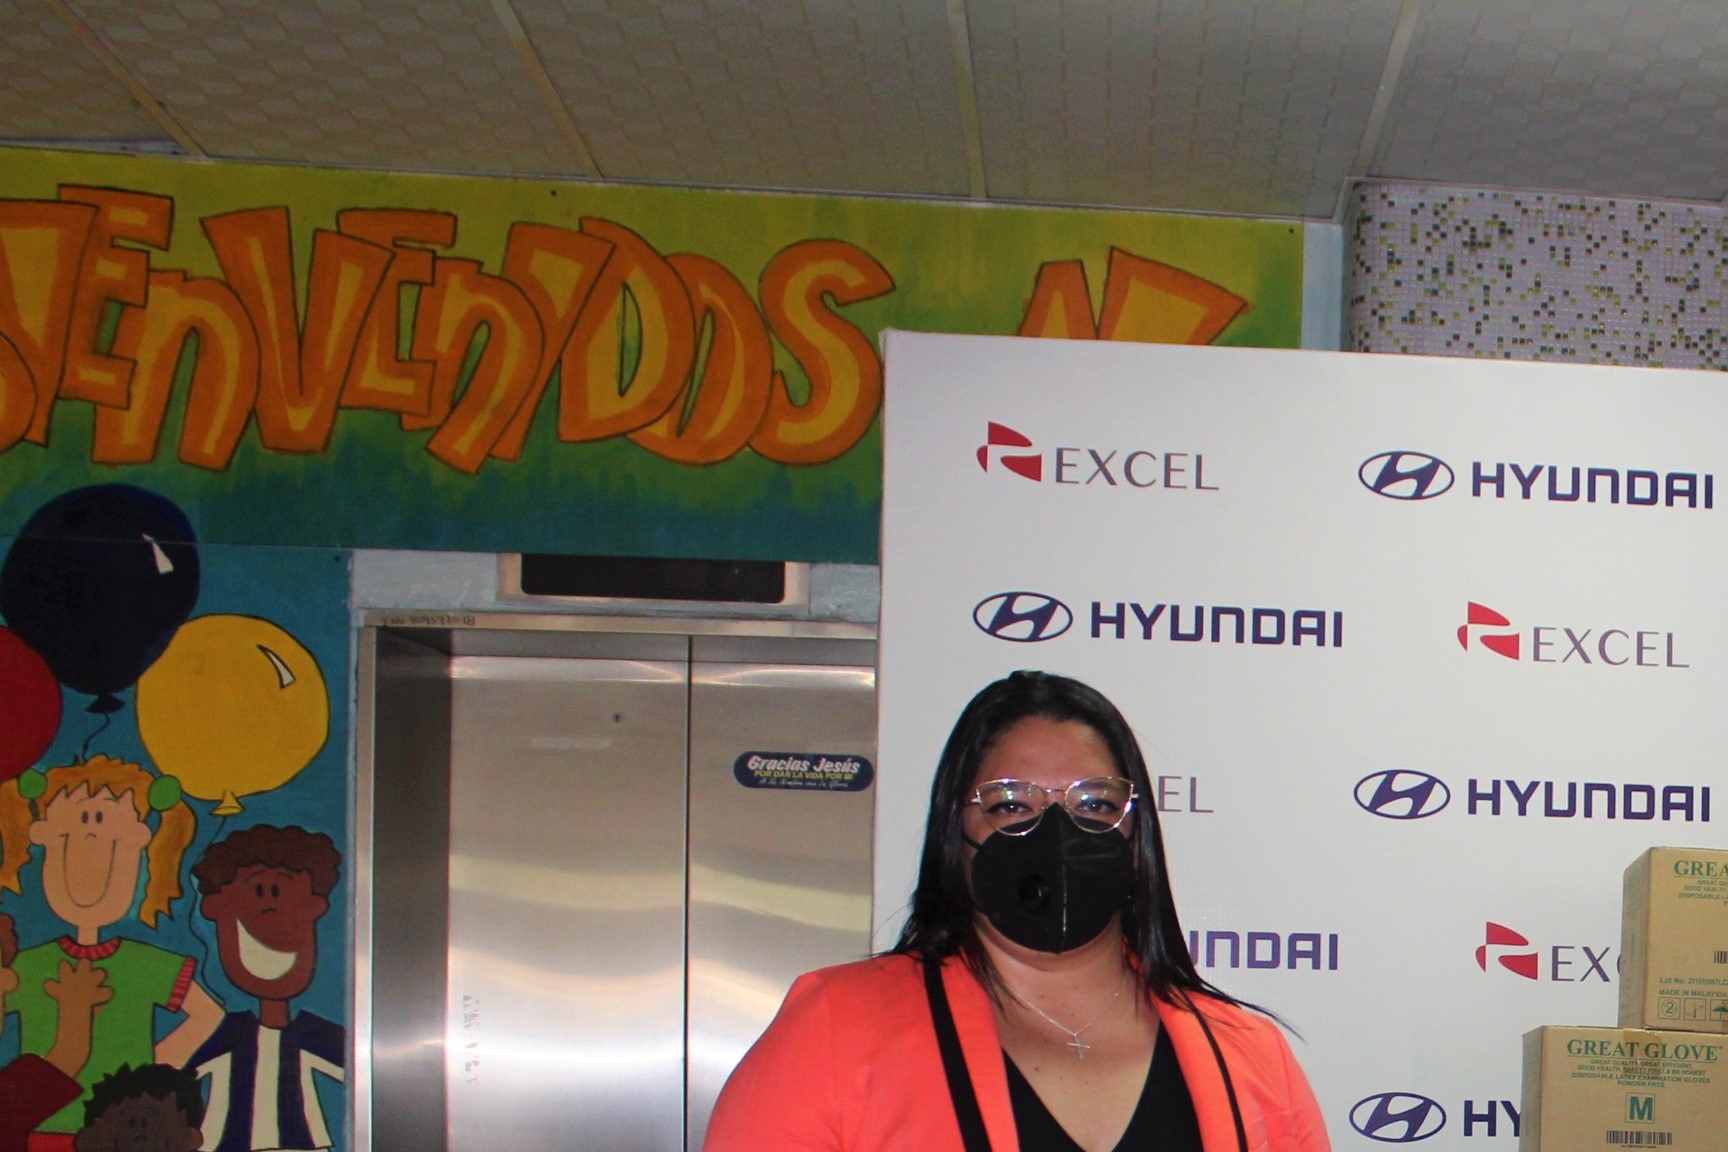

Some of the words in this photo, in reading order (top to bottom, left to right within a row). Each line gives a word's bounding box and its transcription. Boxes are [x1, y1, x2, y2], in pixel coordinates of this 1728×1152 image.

[0, 183, 894, 474] IENVENIDOS
[1055, 447, 1220, 491] EXCEL
[1473, 462, 1714, 509] HYUNDAI
[1091, 602, 1343, 648] HYUNDAI
[1533, 626, 1690, 669] EXCEL
[748, 755, 810, 771] Gracias
[813, 757, 860, 774] Jesús
[1468, 778, 1710, 822] HYUNDAI
[1189, 930, 1338, 970] NDAI
[1567, 1039, 1639, 1057] GREAT
[1643, 1043, 1718, 1062] GLOVE
[1629, 1096, 1653, 1120] M
